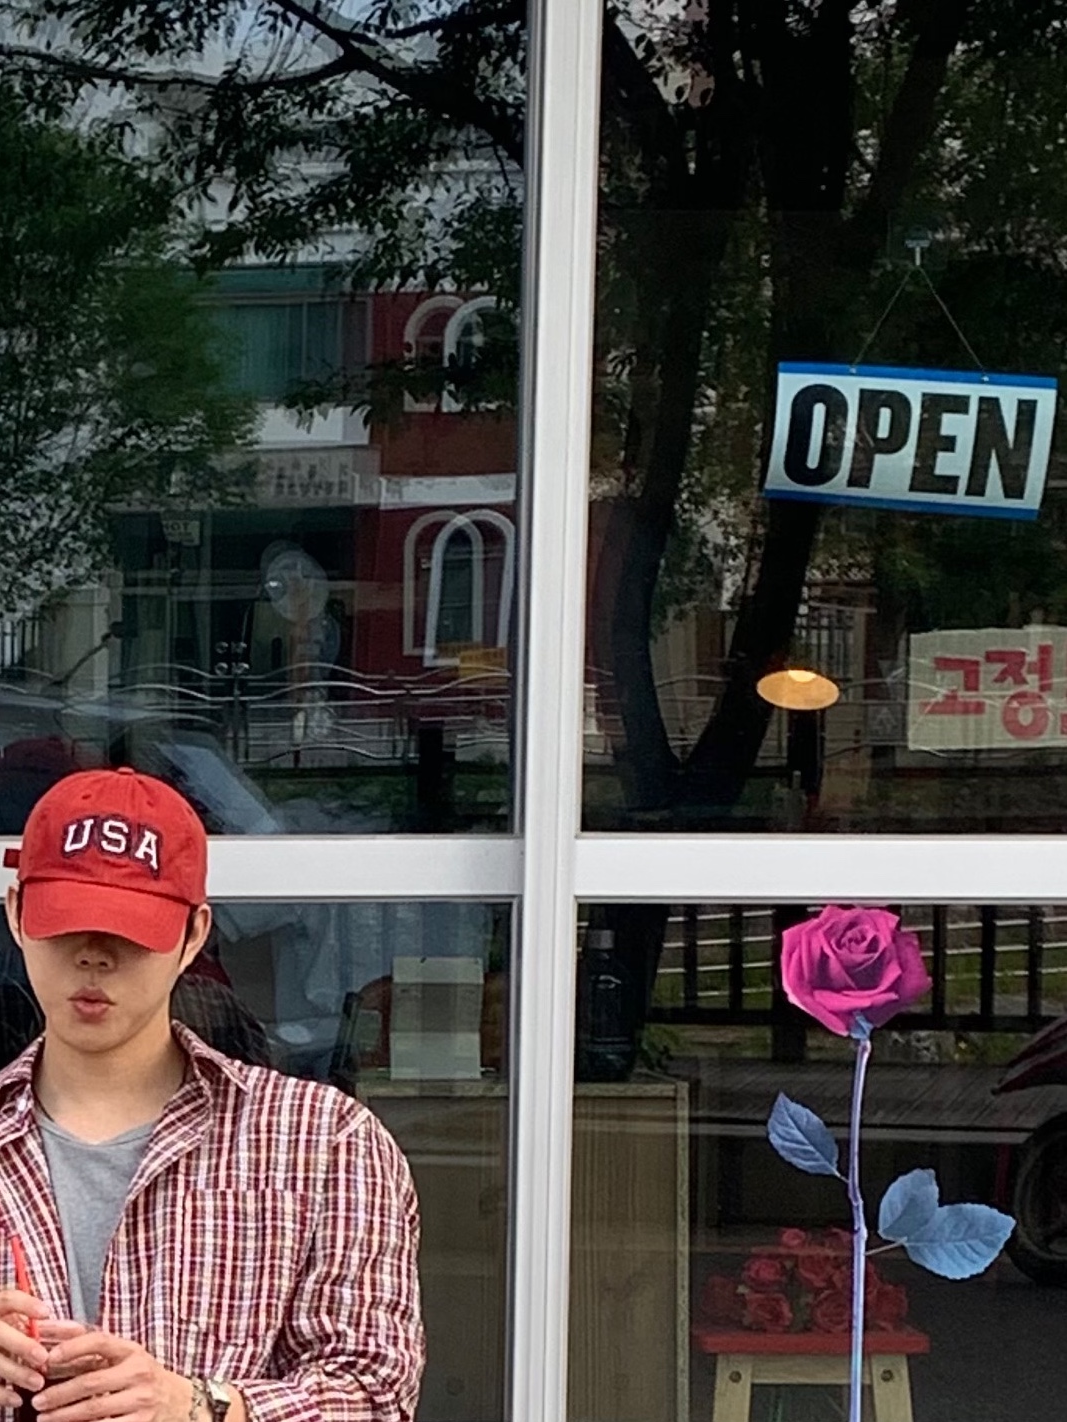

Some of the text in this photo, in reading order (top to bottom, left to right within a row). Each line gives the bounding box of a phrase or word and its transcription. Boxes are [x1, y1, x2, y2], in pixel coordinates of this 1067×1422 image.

[783, 383, 1038, 500] OPEN
[919, 642, 1067, 741] 고정
[62, 817, 161, 877] USA
